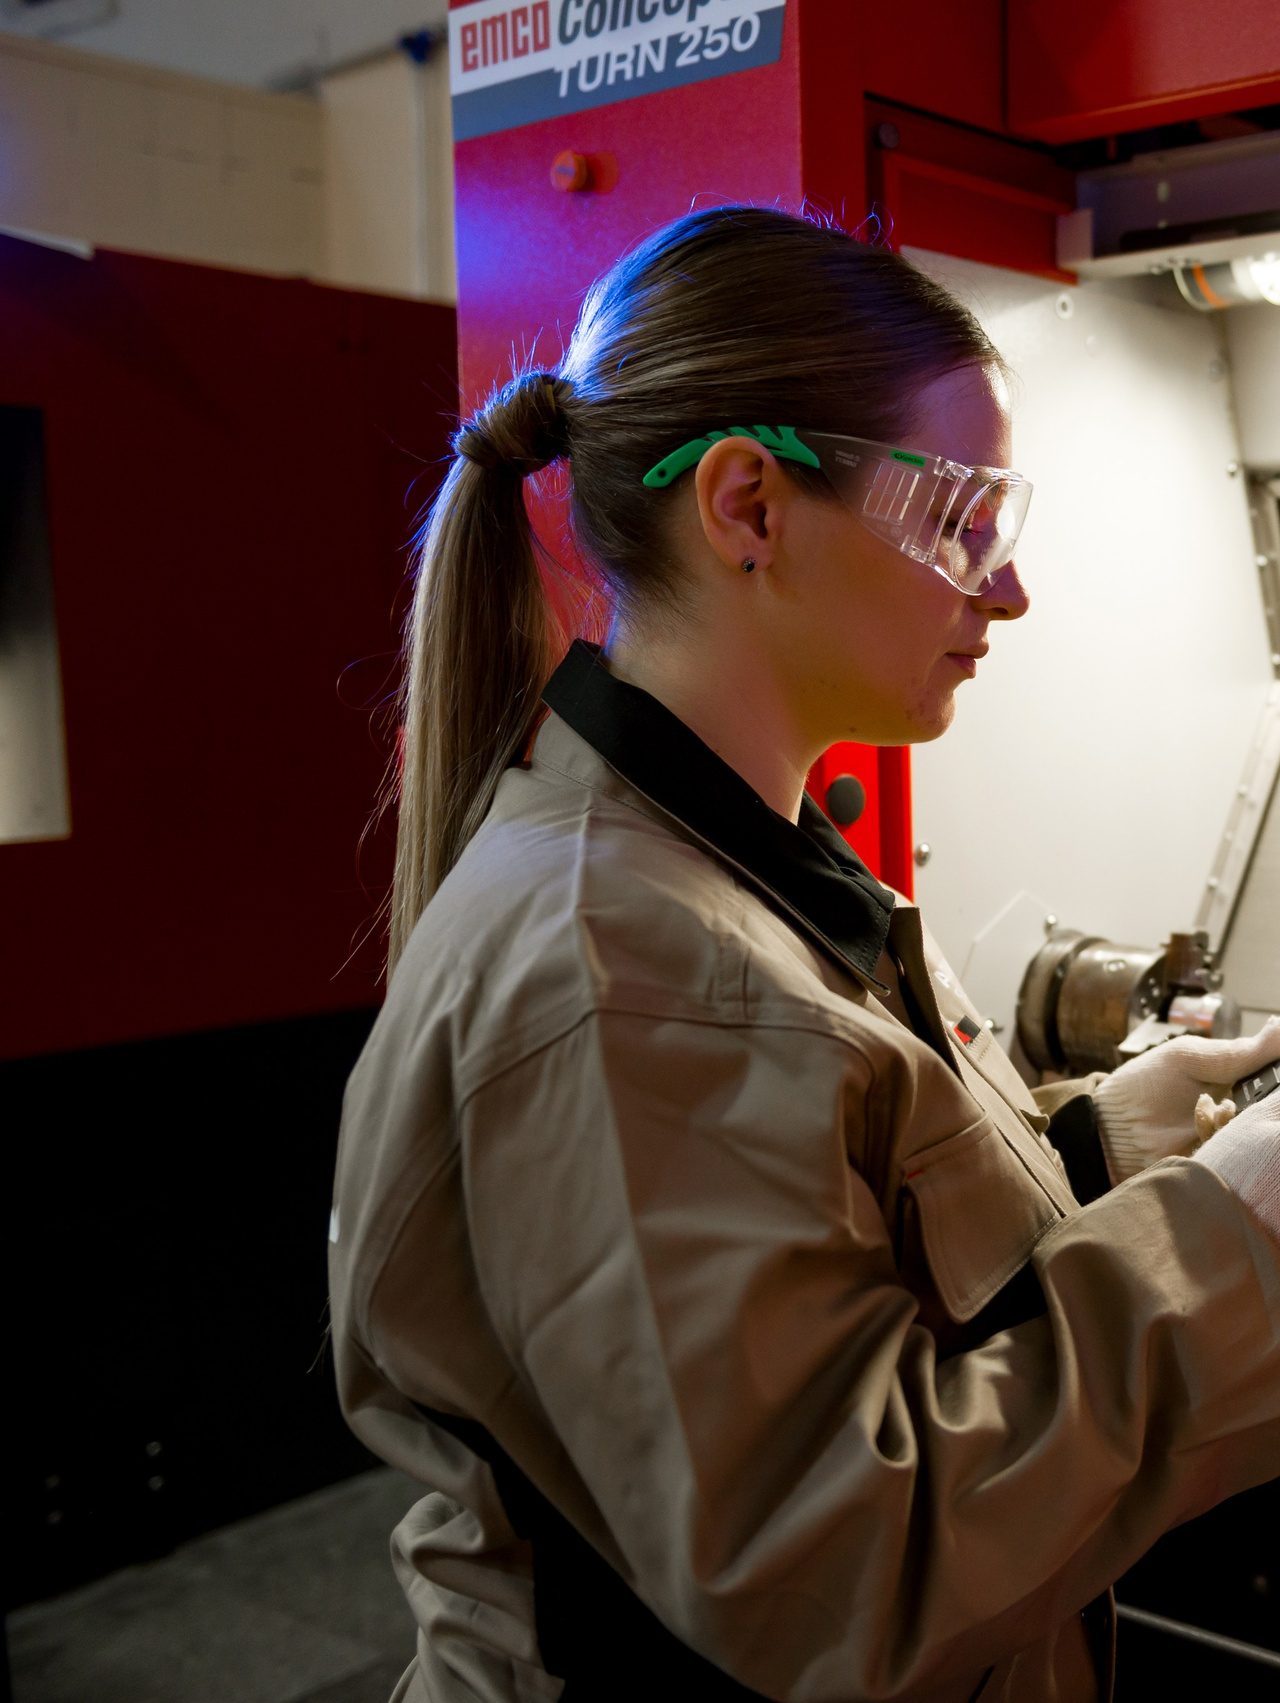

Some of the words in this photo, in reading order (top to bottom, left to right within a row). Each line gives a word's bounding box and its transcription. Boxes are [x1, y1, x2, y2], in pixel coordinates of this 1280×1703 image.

[461, 0, 550, 73] emco
[552, 37, 669, 98] TURN
[675, 12, 760, 68] 250
[556, 0, 732, 45] Conc
